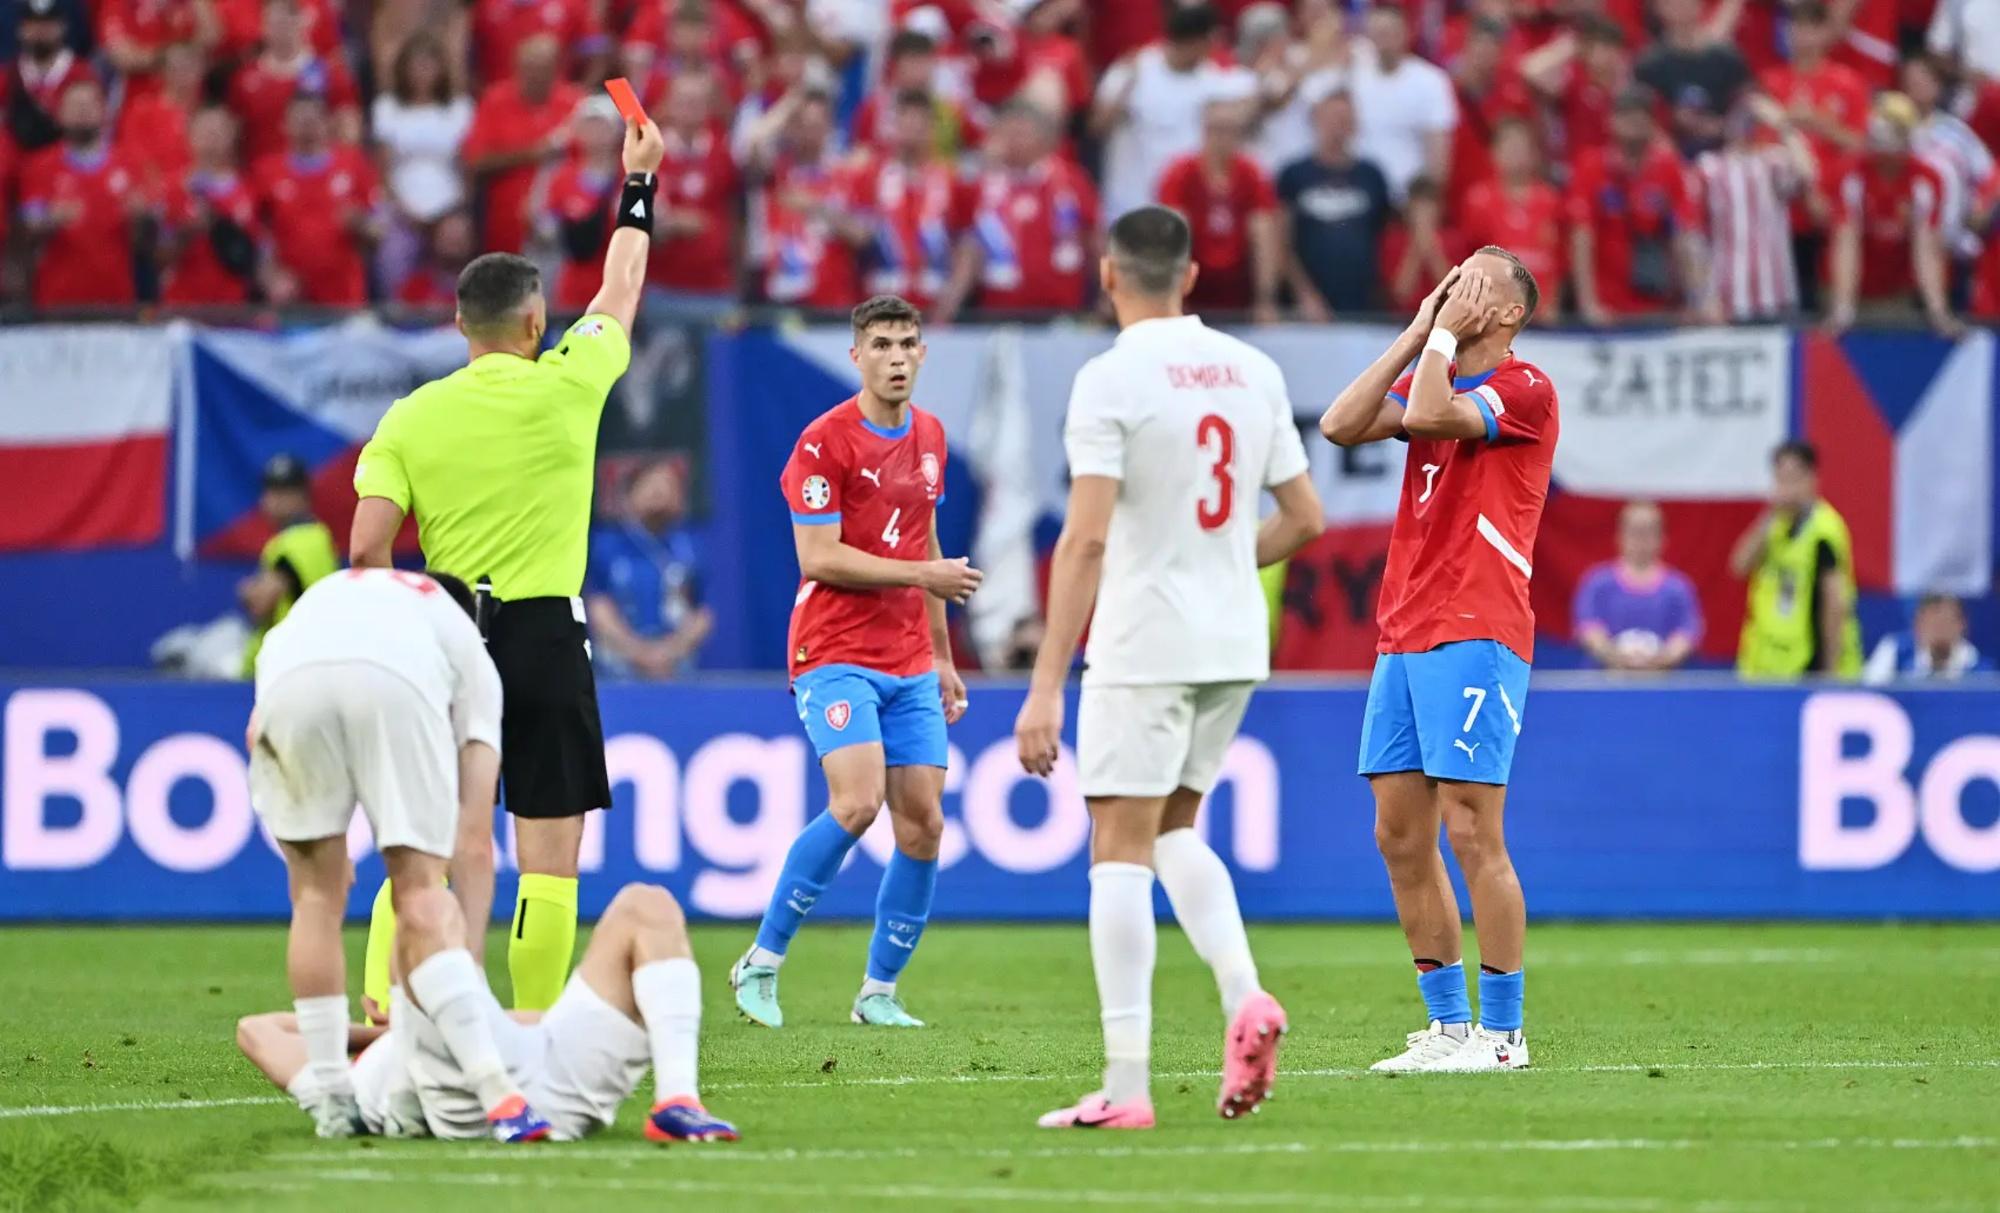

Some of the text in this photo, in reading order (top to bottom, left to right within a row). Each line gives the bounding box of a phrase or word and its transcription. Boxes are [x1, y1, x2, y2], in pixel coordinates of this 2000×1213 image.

[1166, 363, 1247, 389] DEMIRAL
[1196, 413, 1235, 532] 3
[1419, 463, 1441, 503] 7
[881, 507, 901, 549] 4
[1463, 686, 1487, 733] 7
[2, 688, 1278, 918] Bongco
[1801, 690, 2000, 871] Bo
